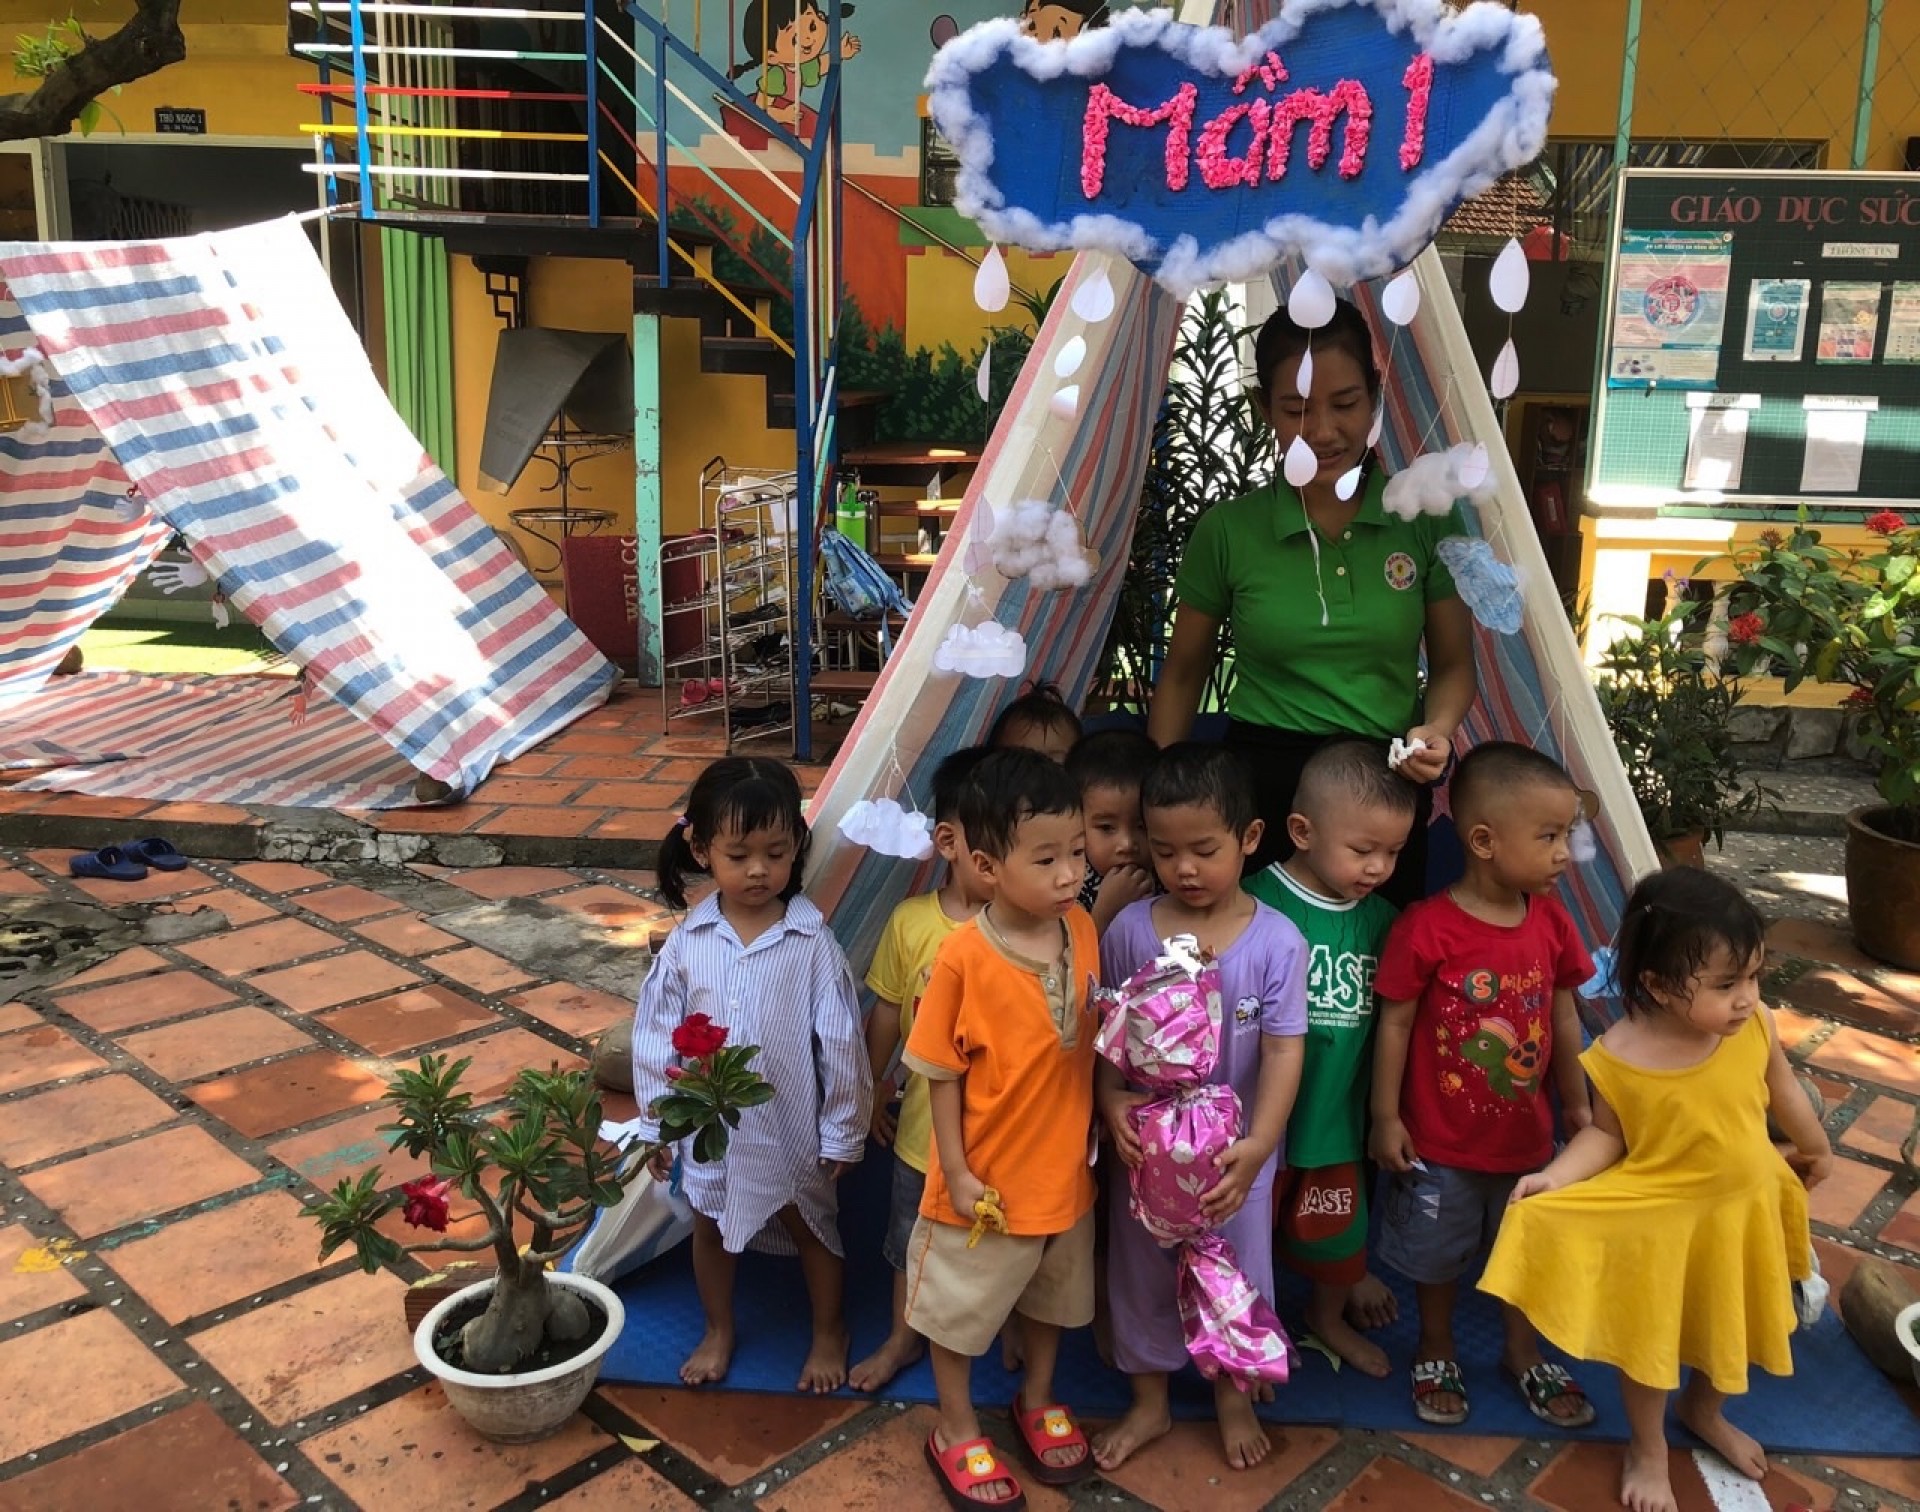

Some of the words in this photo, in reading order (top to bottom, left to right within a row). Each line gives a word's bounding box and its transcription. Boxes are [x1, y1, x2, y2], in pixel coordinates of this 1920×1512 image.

[1081, 51, 1372, 199] Mầm
[1399, 53, 1434, 171] 1
[1670, 187, 1762, 223] GIÁO
[1776, 196, 1848, 231] DỤC
[1306, 944, 1378, 1015] ASE
